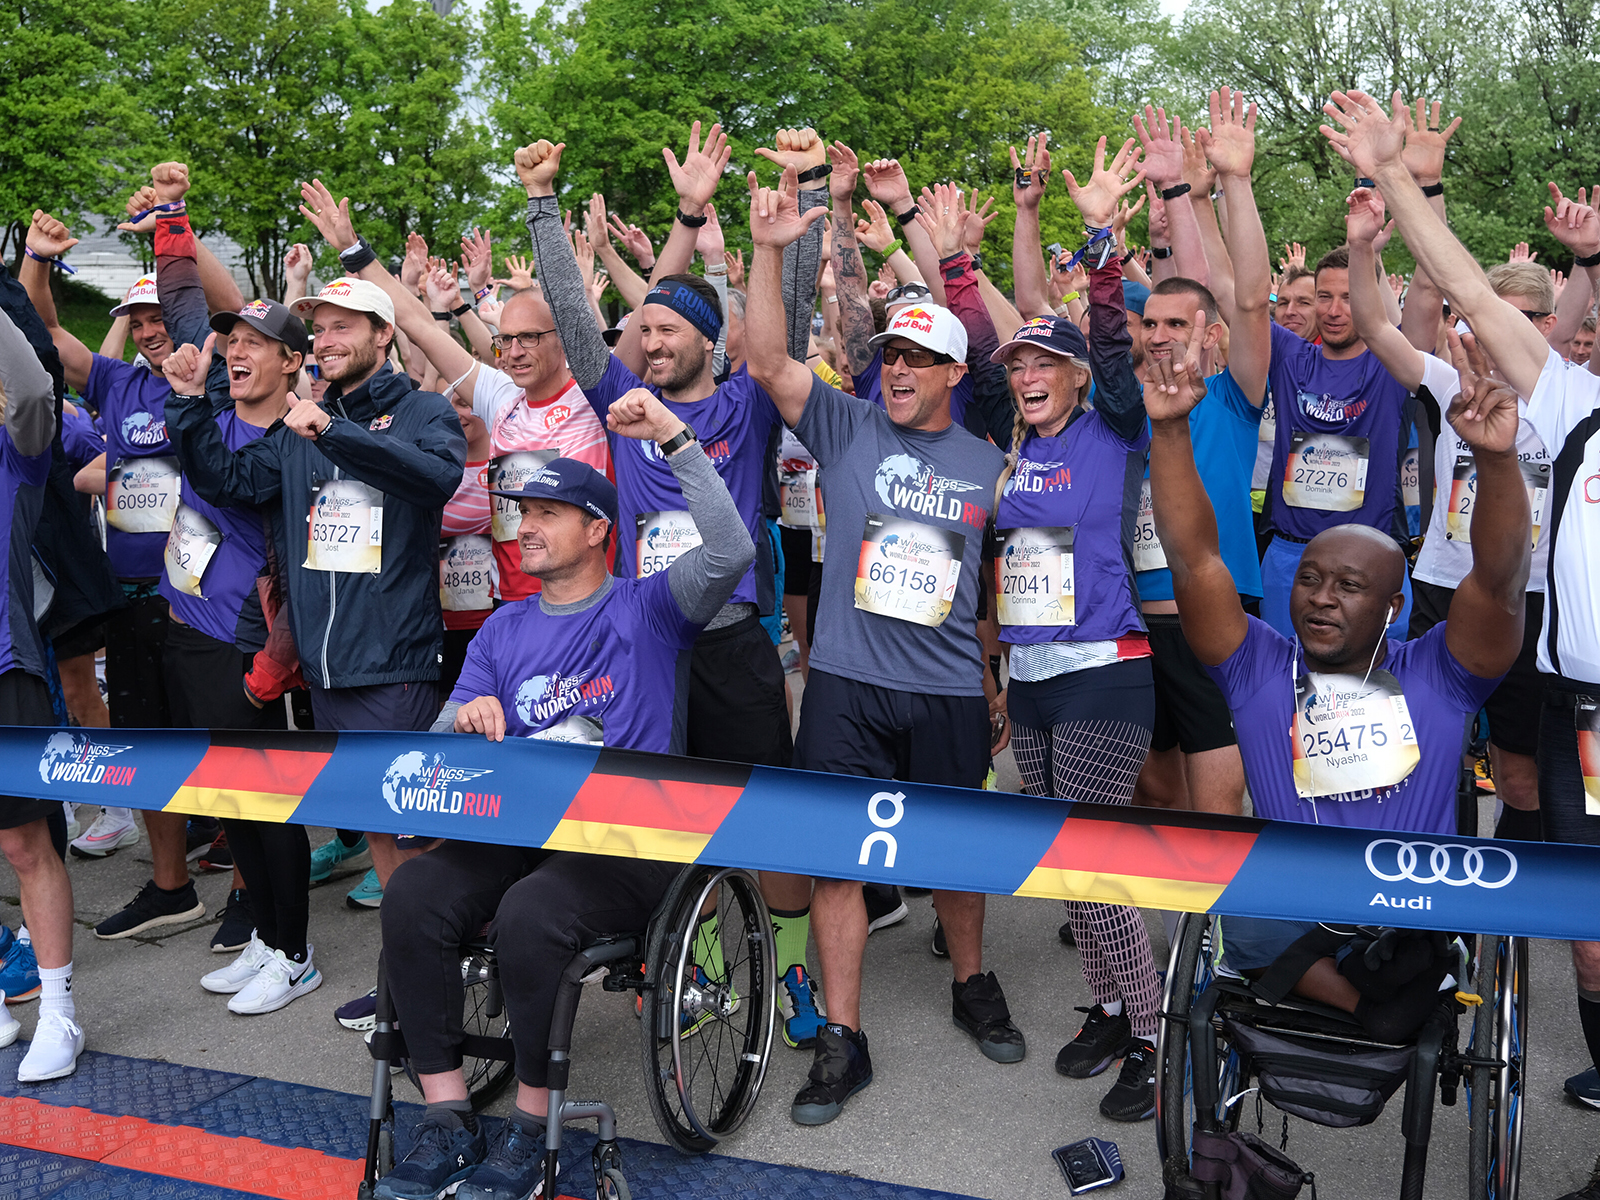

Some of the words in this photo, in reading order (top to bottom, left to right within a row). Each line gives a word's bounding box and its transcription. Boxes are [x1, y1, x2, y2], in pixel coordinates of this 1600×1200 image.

[140, 287, 157, 295] Bull
[331, 288, 351, 297] Bull
[671, 298, 686, 311] FOR
[893, 319, 911, 330] Red
[910, 320, 932, 334] Bull
[1031, 327, 1052, 338] Bull
[507, 468, 530, 477] WINGS
[1294, 468, 1348, 488] 27276
[918, 473, 959, 490] WINGS
[1357, 477, 1363, 487] 1
[920, 484, 945, 496] LIFE
[1305, 485, 1333, 494] Dominik
[117, 493, 168, 510] 60997
[1533, 510, 1540, 522] 1
[313, 524, 361, 543] 53727
[371, 530, 379, 542] 4
[662, 528, 691, 536] WINGS
[325, 544, 339, 552] Jost
[900, 539, 932, 552] WINGS
[902, 546, 920, 557] LIFE
[917, 557, 930, 566] 2022
[444, 570, 491, 588] 48481
[869, 562, 937, 594] 66158
[1003, 575, 1049, 594] 27041
[1062, 578, 1072, 591] 4
[1012, 596, 1037, 604] Corinna
[1319, 692, 1358, 704] WINGS
[1326, 700, 1348, 712] LIFE
[1350, 708, 1365, 716] 2022
[1400, 724, 1413, 740] 2
[1303, 723, 1387, 758] 25475
[74, 742, 110, 755] WINGS
[75, 754, 98, 764] LIFE
[1326, 753, 1368, 768] Nyasha
[421, 765, 464, 780] WINGS
[424, 778, 450, 789] LIFE
[1369, 892, 1432, 910] Audi
